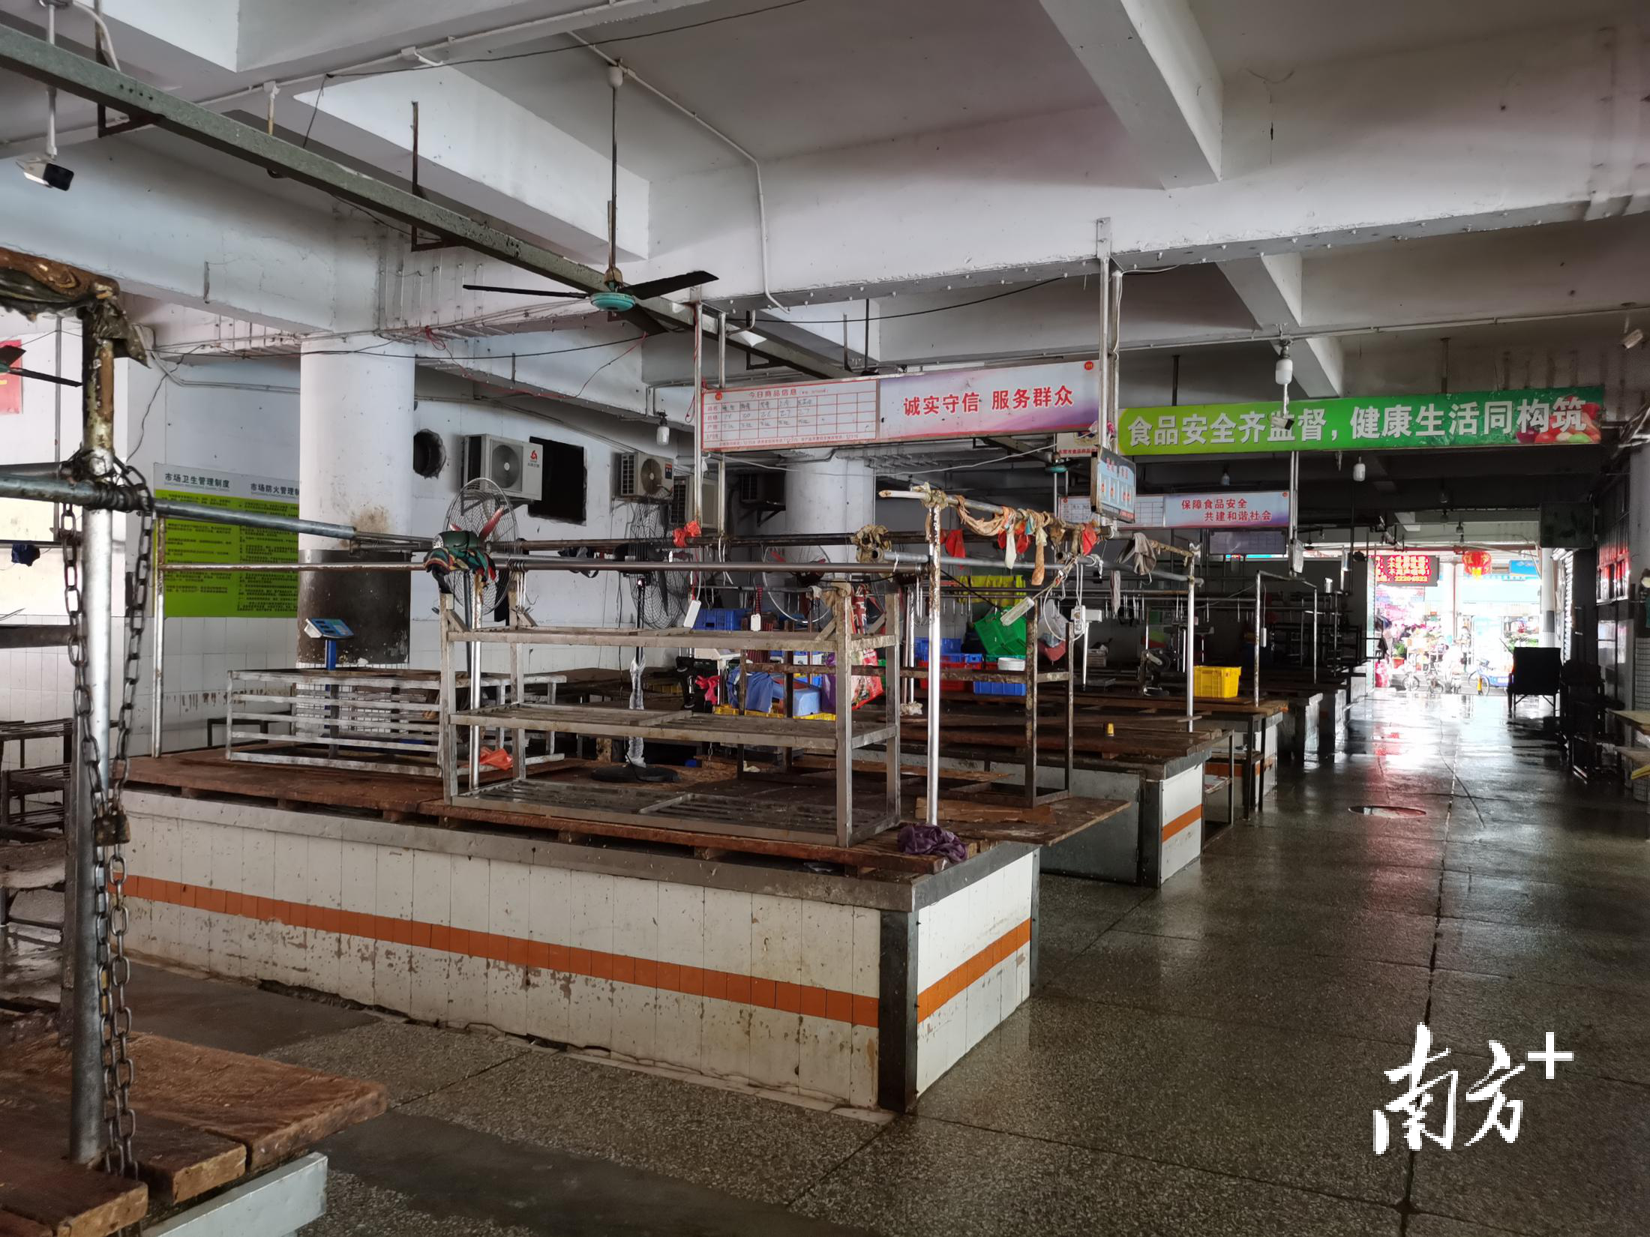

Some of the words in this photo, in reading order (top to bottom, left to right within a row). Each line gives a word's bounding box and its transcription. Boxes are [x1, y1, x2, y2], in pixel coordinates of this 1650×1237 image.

[903, 391, 980, 416] 诚实守信
[991, 384, 1074, 410] 服务群众
[164, 472, 230, 488] 市场卫生管理制度
[1181, 498, 1248, 510] 保障食品安全
[1204, 510, 1272, 522] 共建和谐社会
